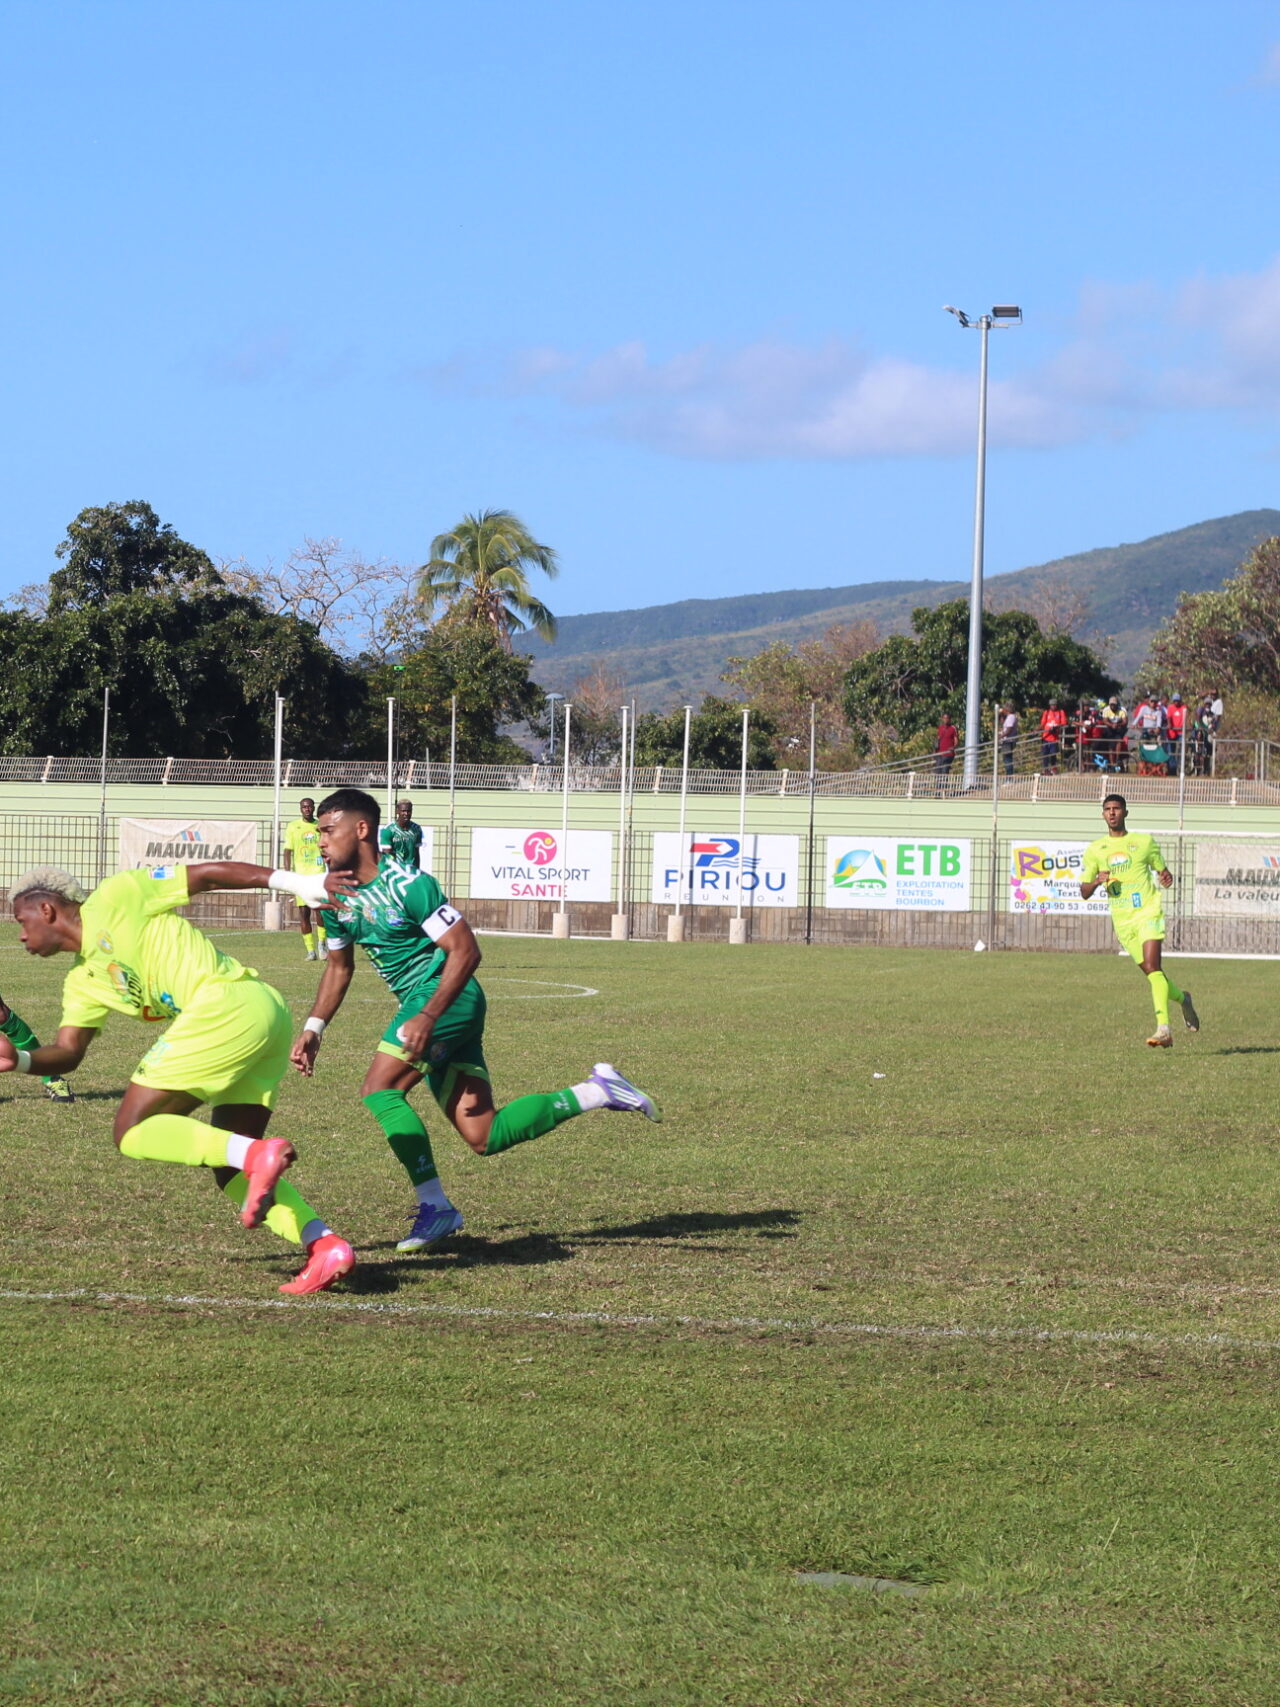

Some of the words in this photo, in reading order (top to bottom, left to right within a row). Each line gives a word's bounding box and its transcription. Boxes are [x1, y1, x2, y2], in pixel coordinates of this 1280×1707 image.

[145, 842, 234, 860] MAUVILAC
[896, 844, 961, 876] ETB
[1017, 850, 1085, 877] ROUS
[491, 866, 535, 880] VITAL
[538, 867, 590, 881] SPORT
[664, 869, 786, 891] PIRIOU
[896, 880, 964, 889] EXPLOITATION
[1043, 880, 1081, 888] Marqua
[511, 883, 568, 897] SANTE
[896, 889, 933, 897] TENTES
[1214, 888, 1232, 899] La
[664, 892, 785, 903] REUNION
[896, 897, 944, 906] BOURBON
[1014, 901, 1037, 909] 0262
[1054, 902, 1065, 910] 90
[437, 907, 455, 926] C
